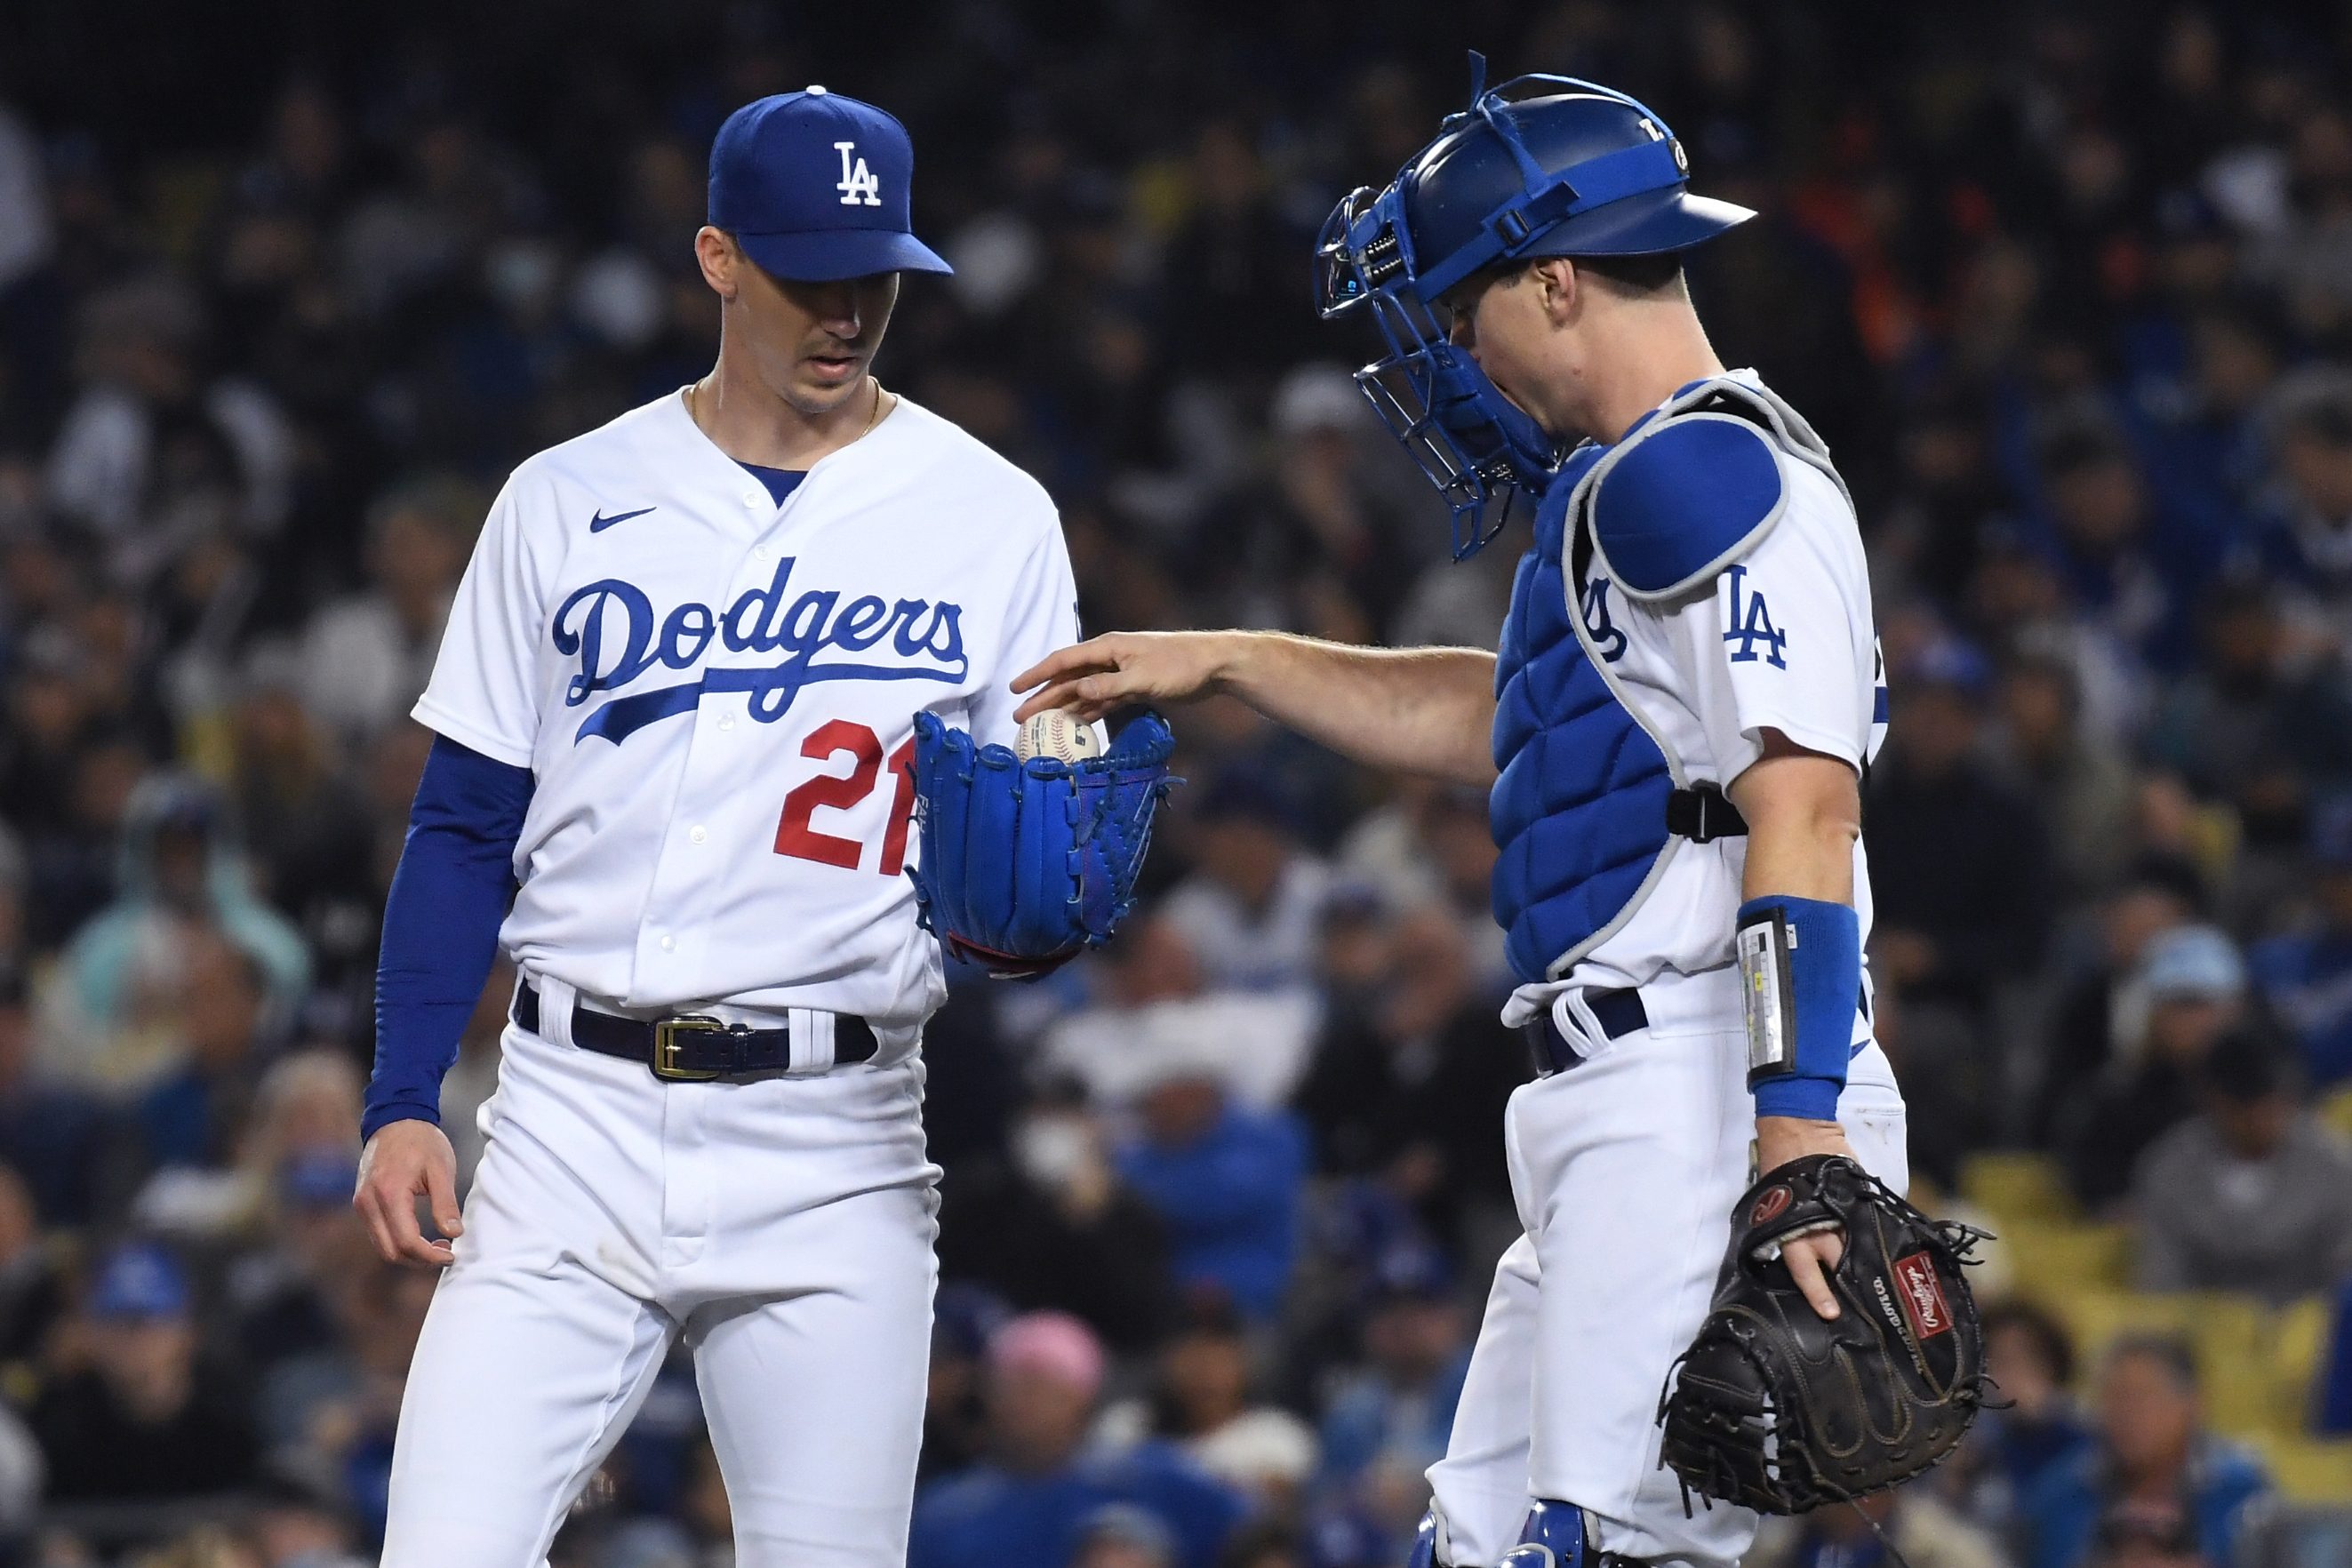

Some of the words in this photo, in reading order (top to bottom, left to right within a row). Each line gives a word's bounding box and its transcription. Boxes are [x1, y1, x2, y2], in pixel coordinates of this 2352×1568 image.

[834, 141, 881, 206] LA
[552, 556, 968, 724] Dodgers
[1723, 564, 1787, 670] LA
[773, 718, 916, 876] 21
[1879, 1294, 1901, 1327] GLOVE
